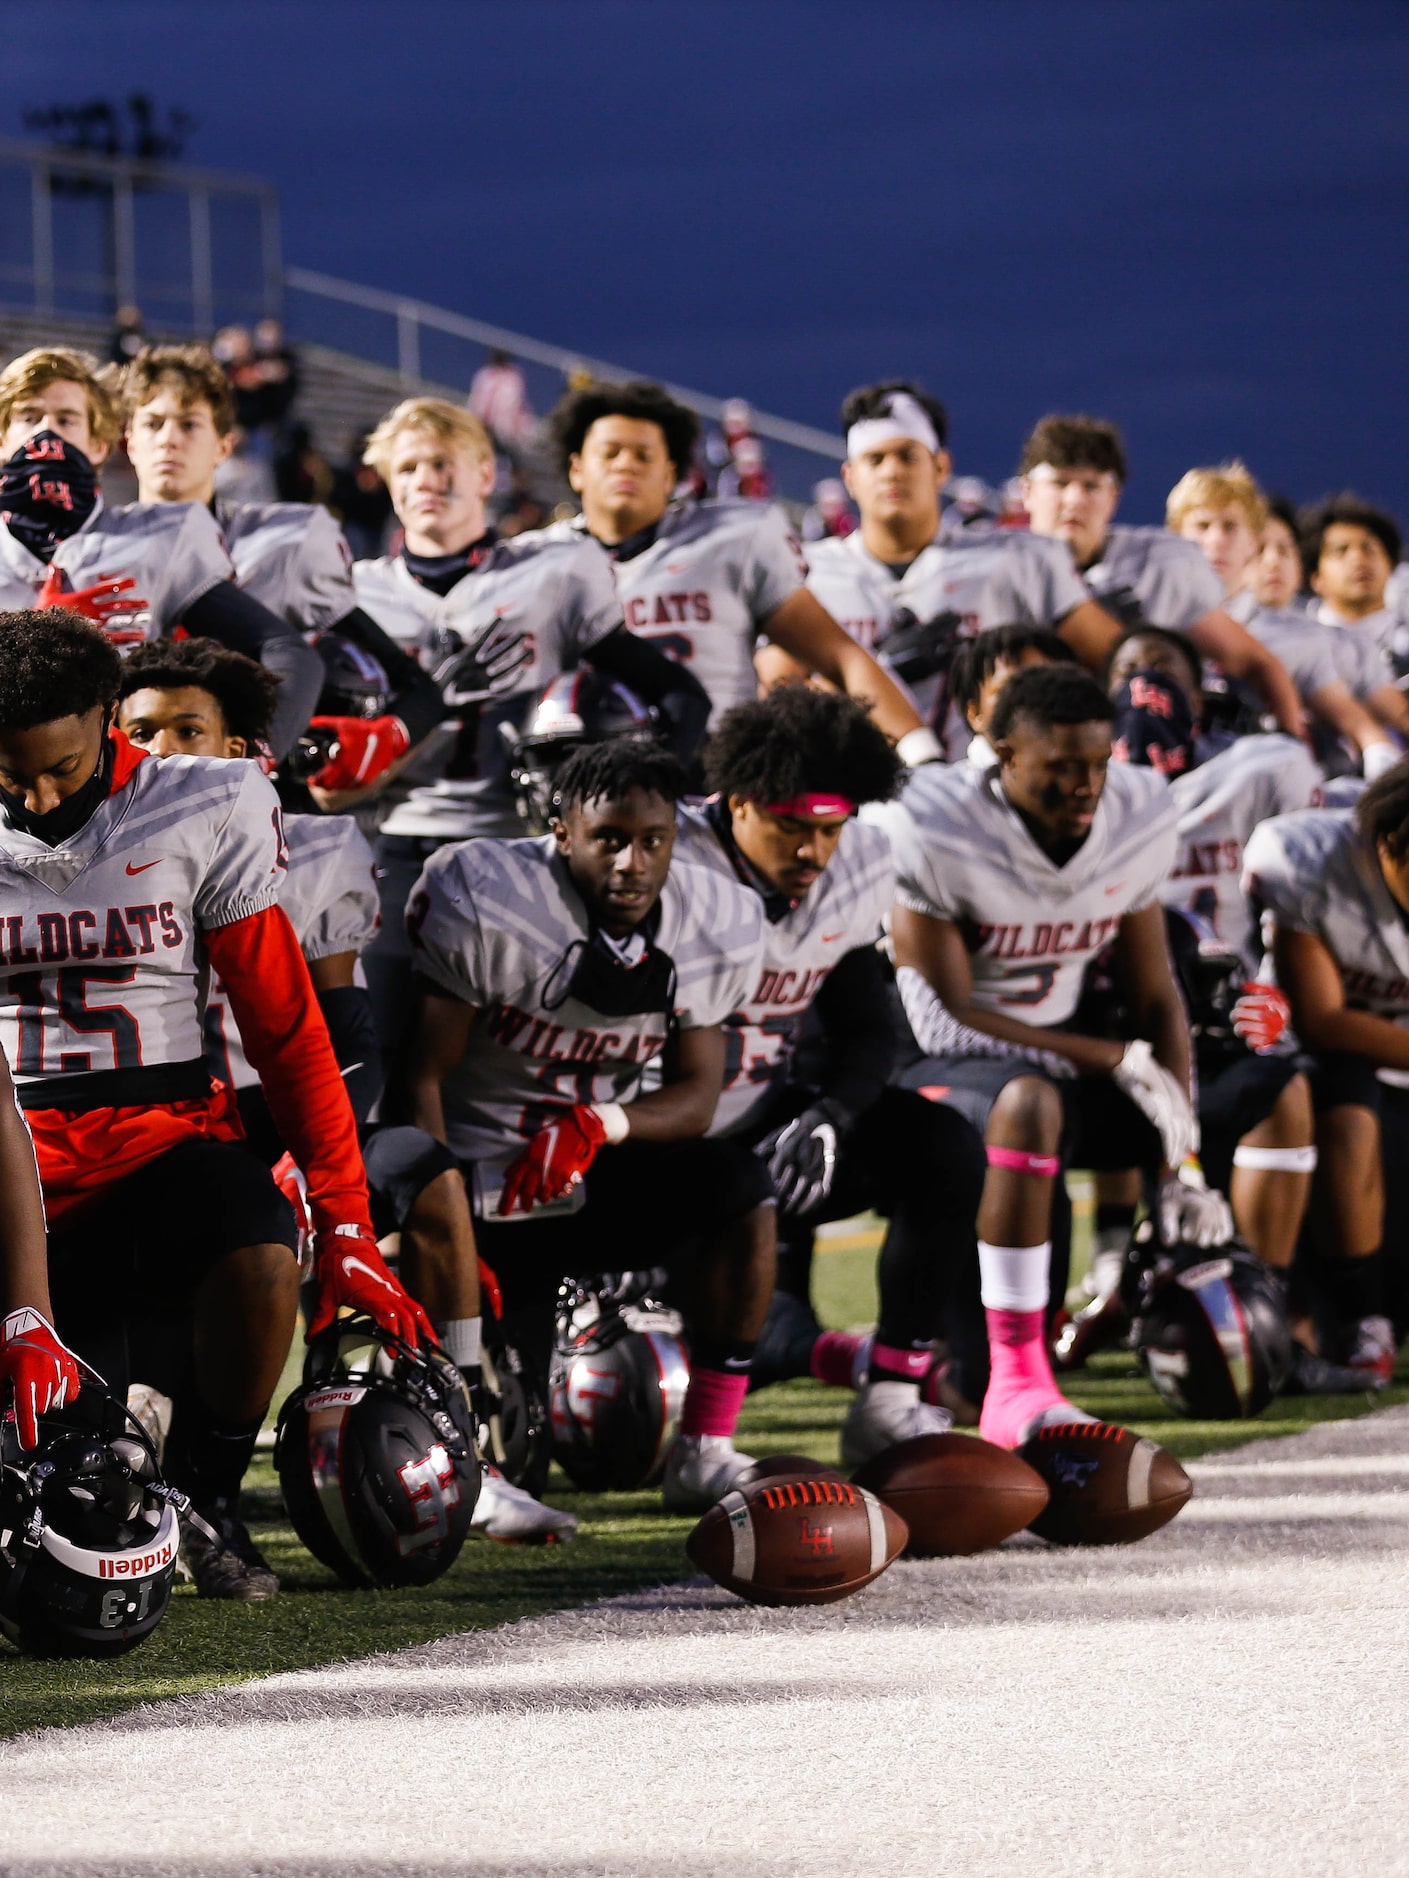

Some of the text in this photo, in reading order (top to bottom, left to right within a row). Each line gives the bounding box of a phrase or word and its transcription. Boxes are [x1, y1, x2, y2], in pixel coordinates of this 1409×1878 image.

[7, 963, 144, 1073] 15
[798, 1517, 834, 1556] LH
[98, 1542, 174, 1580] Riddell
[99, 1580, 153, 1629] 13
